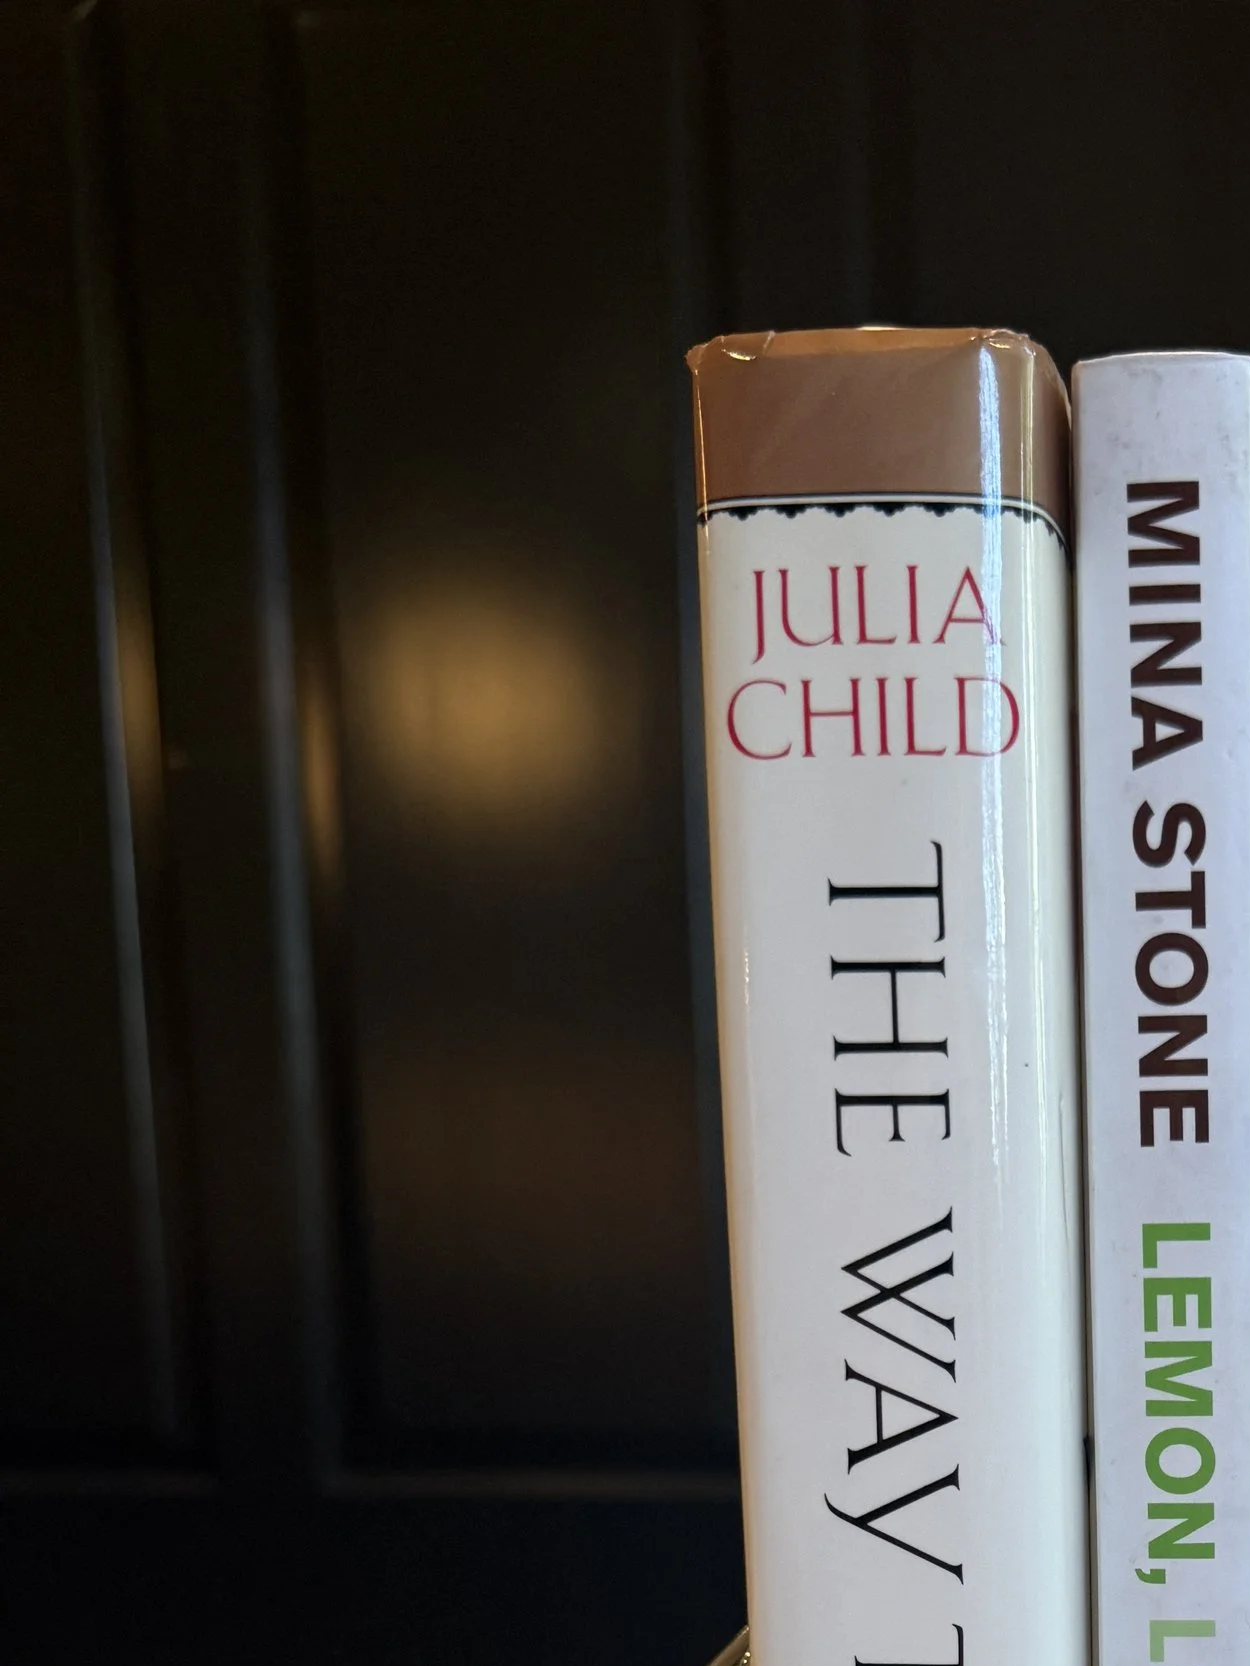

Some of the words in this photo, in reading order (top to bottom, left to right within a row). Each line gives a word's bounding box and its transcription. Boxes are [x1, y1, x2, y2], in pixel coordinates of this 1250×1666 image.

[726, 676, 1021, 762] CHILD
[752, 564, 1007, 664] JULIA
[1127, 480, 1205, 771] MINA
[827, 840, 951, 1157] THE
[1132, 801, 1210, 1147] STONE
[825, 1207, 964, 1585] WAY
[1135, 1222, 1216, 1584] LEMON,
